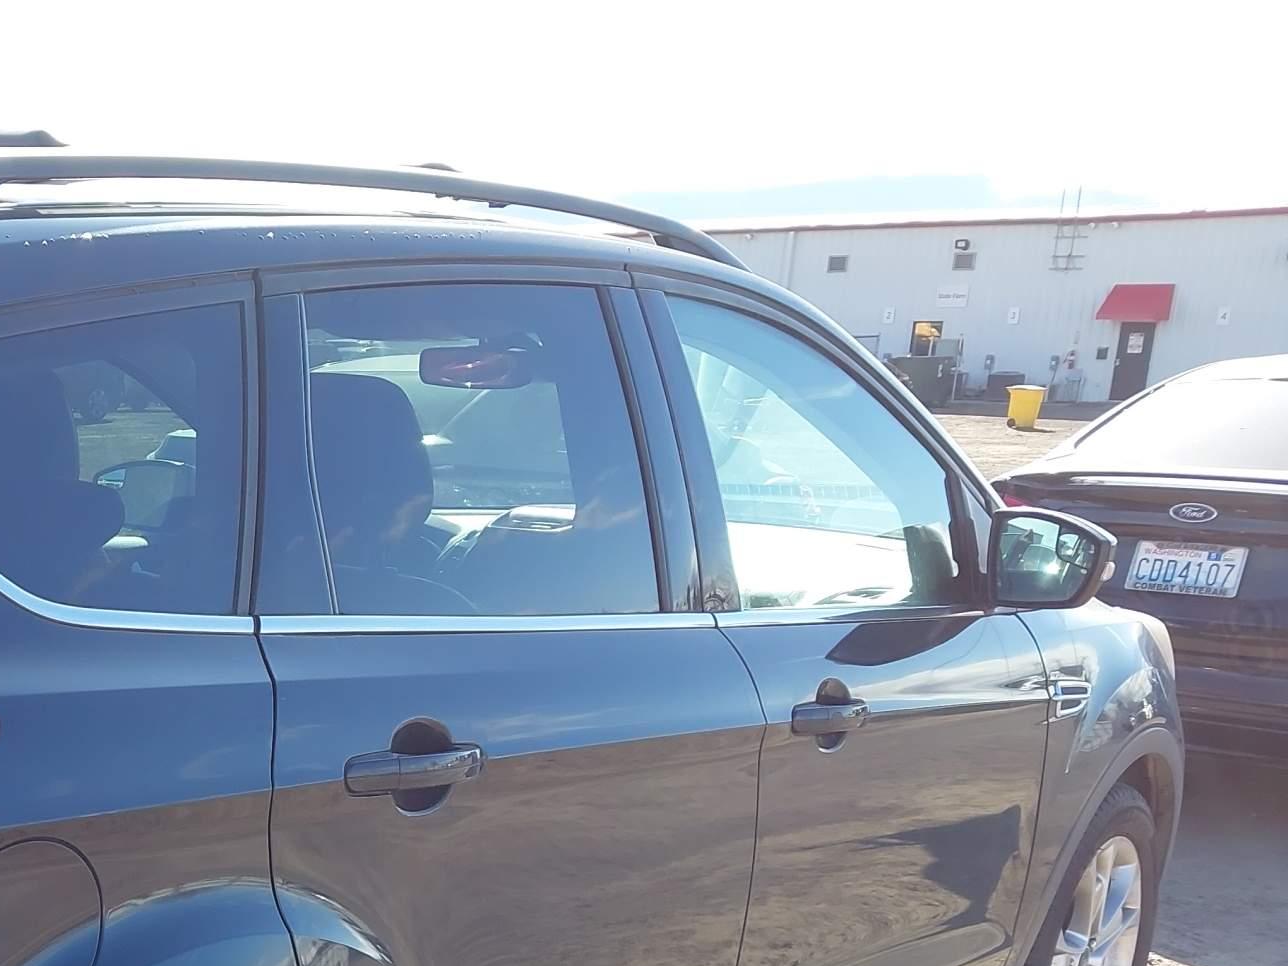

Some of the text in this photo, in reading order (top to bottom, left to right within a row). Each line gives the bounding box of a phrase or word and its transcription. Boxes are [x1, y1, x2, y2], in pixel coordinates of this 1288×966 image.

[1144, 548, 1202, 559] WASHINGTON
[1135, 557, 1236, 587] CDD4107
[1133, 582, 1228, 596] COMBAT VETERAN
